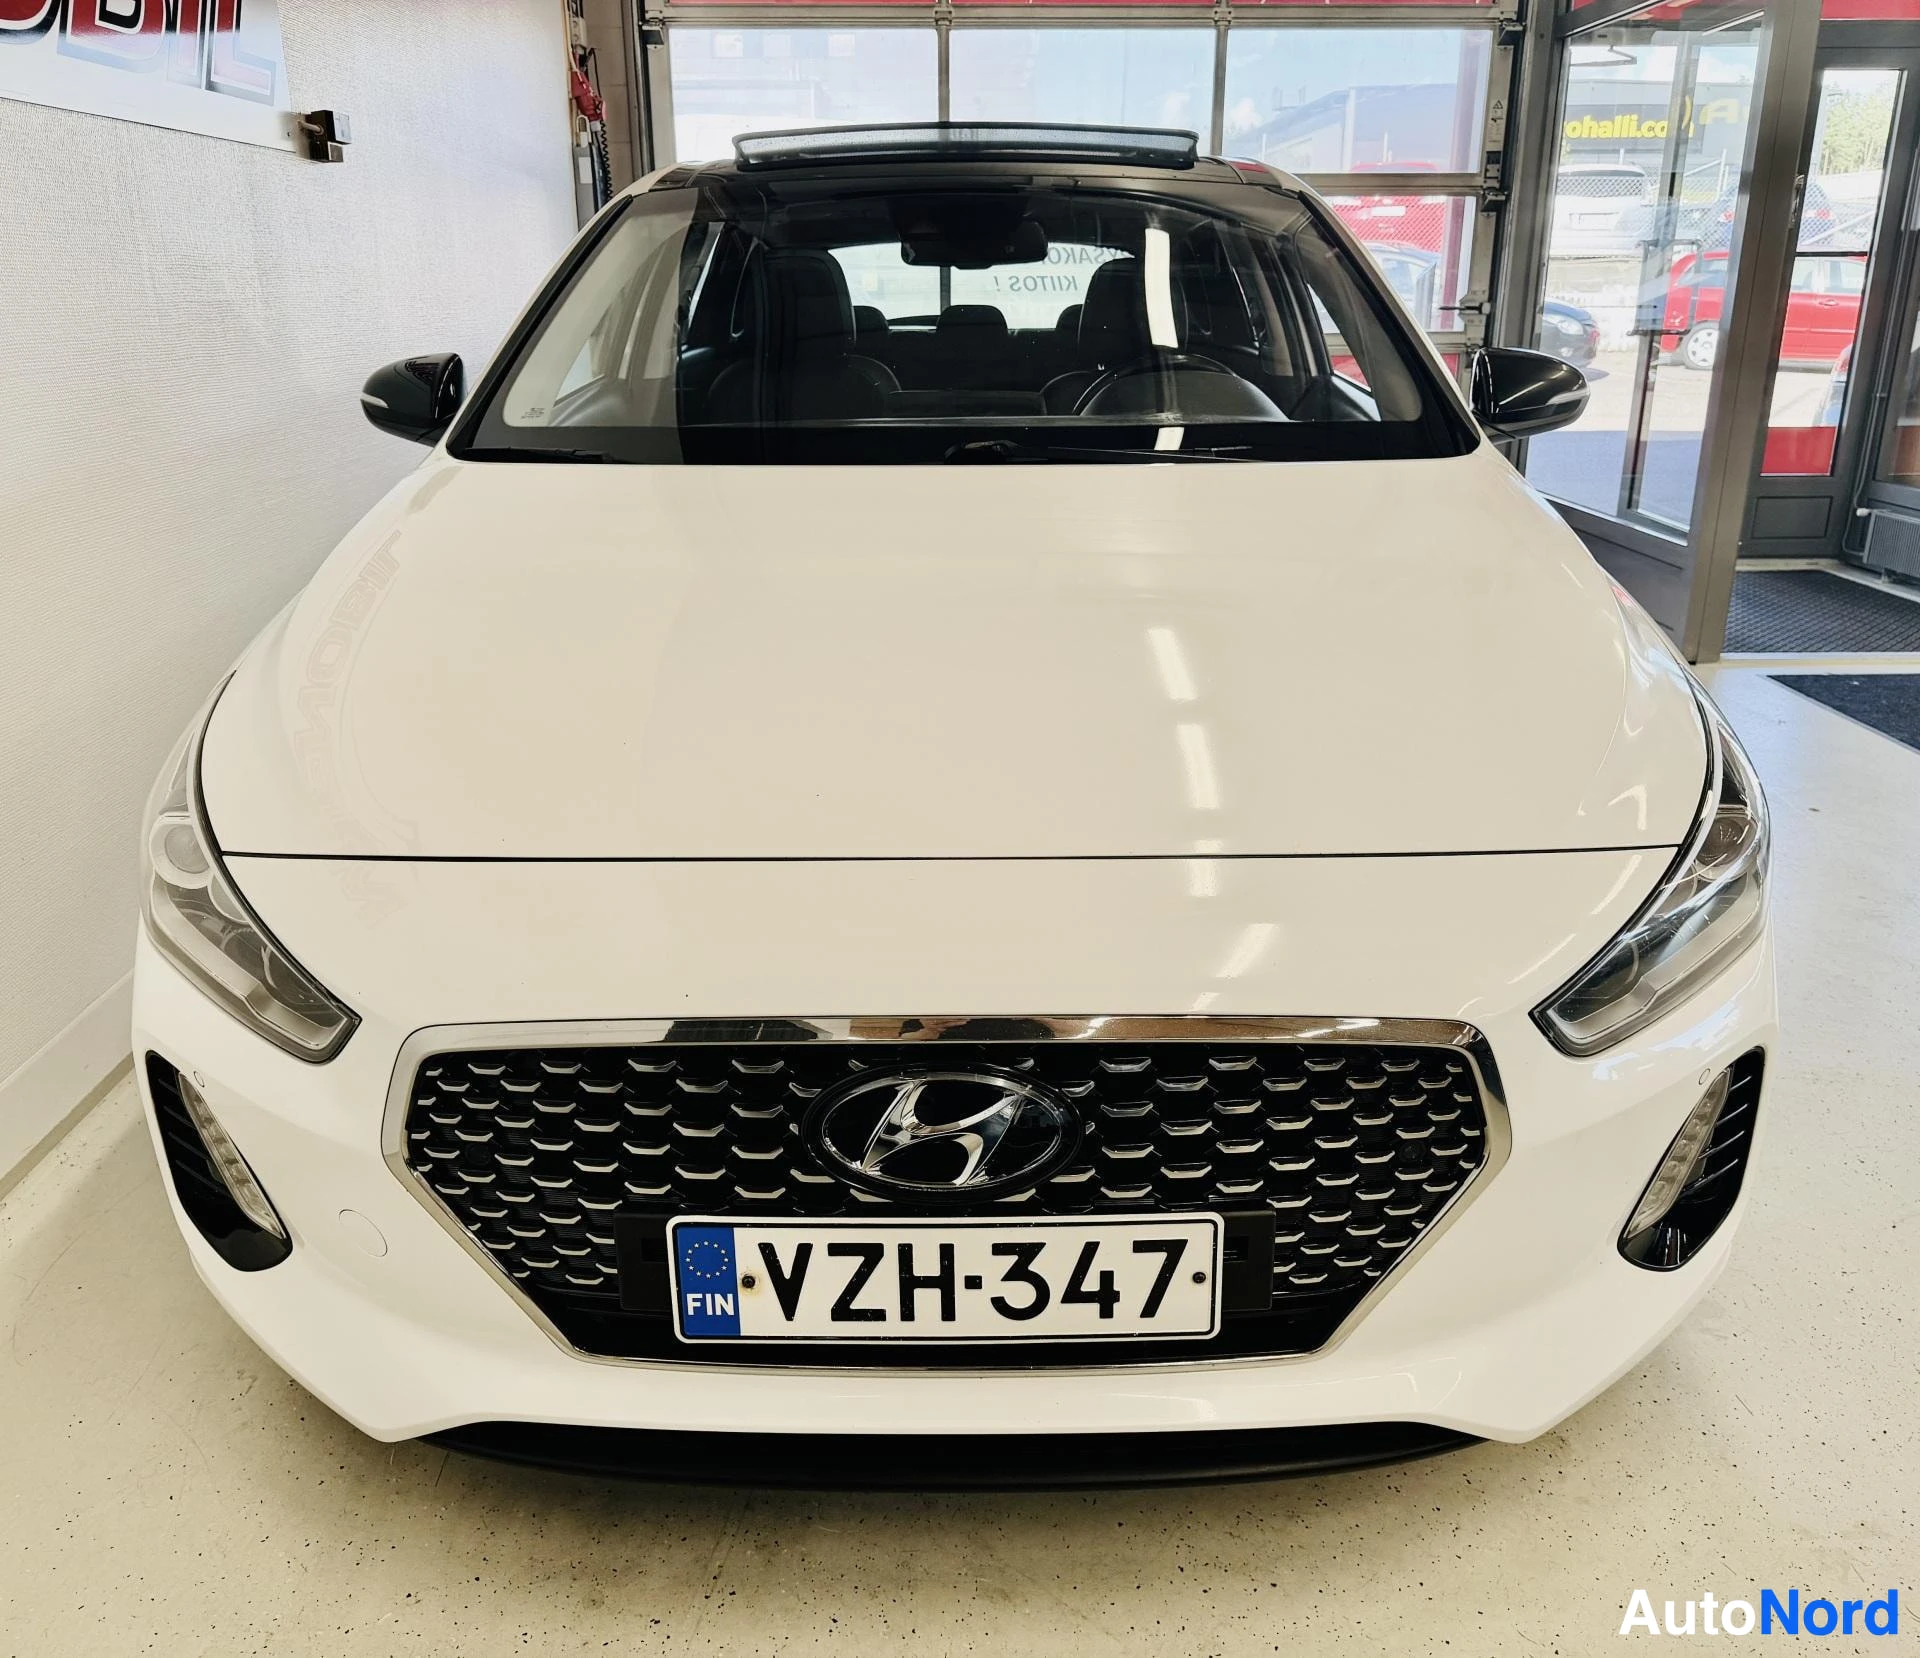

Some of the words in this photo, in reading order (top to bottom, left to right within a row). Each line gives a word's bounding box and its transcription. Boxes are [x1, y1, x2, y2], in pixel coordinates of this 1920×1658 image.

[1563, 114, 1695, 138] ohalli.co
[758, 1239, 1188, 1322] VZH-347
[686, 1293, 735, 1317] FIN
